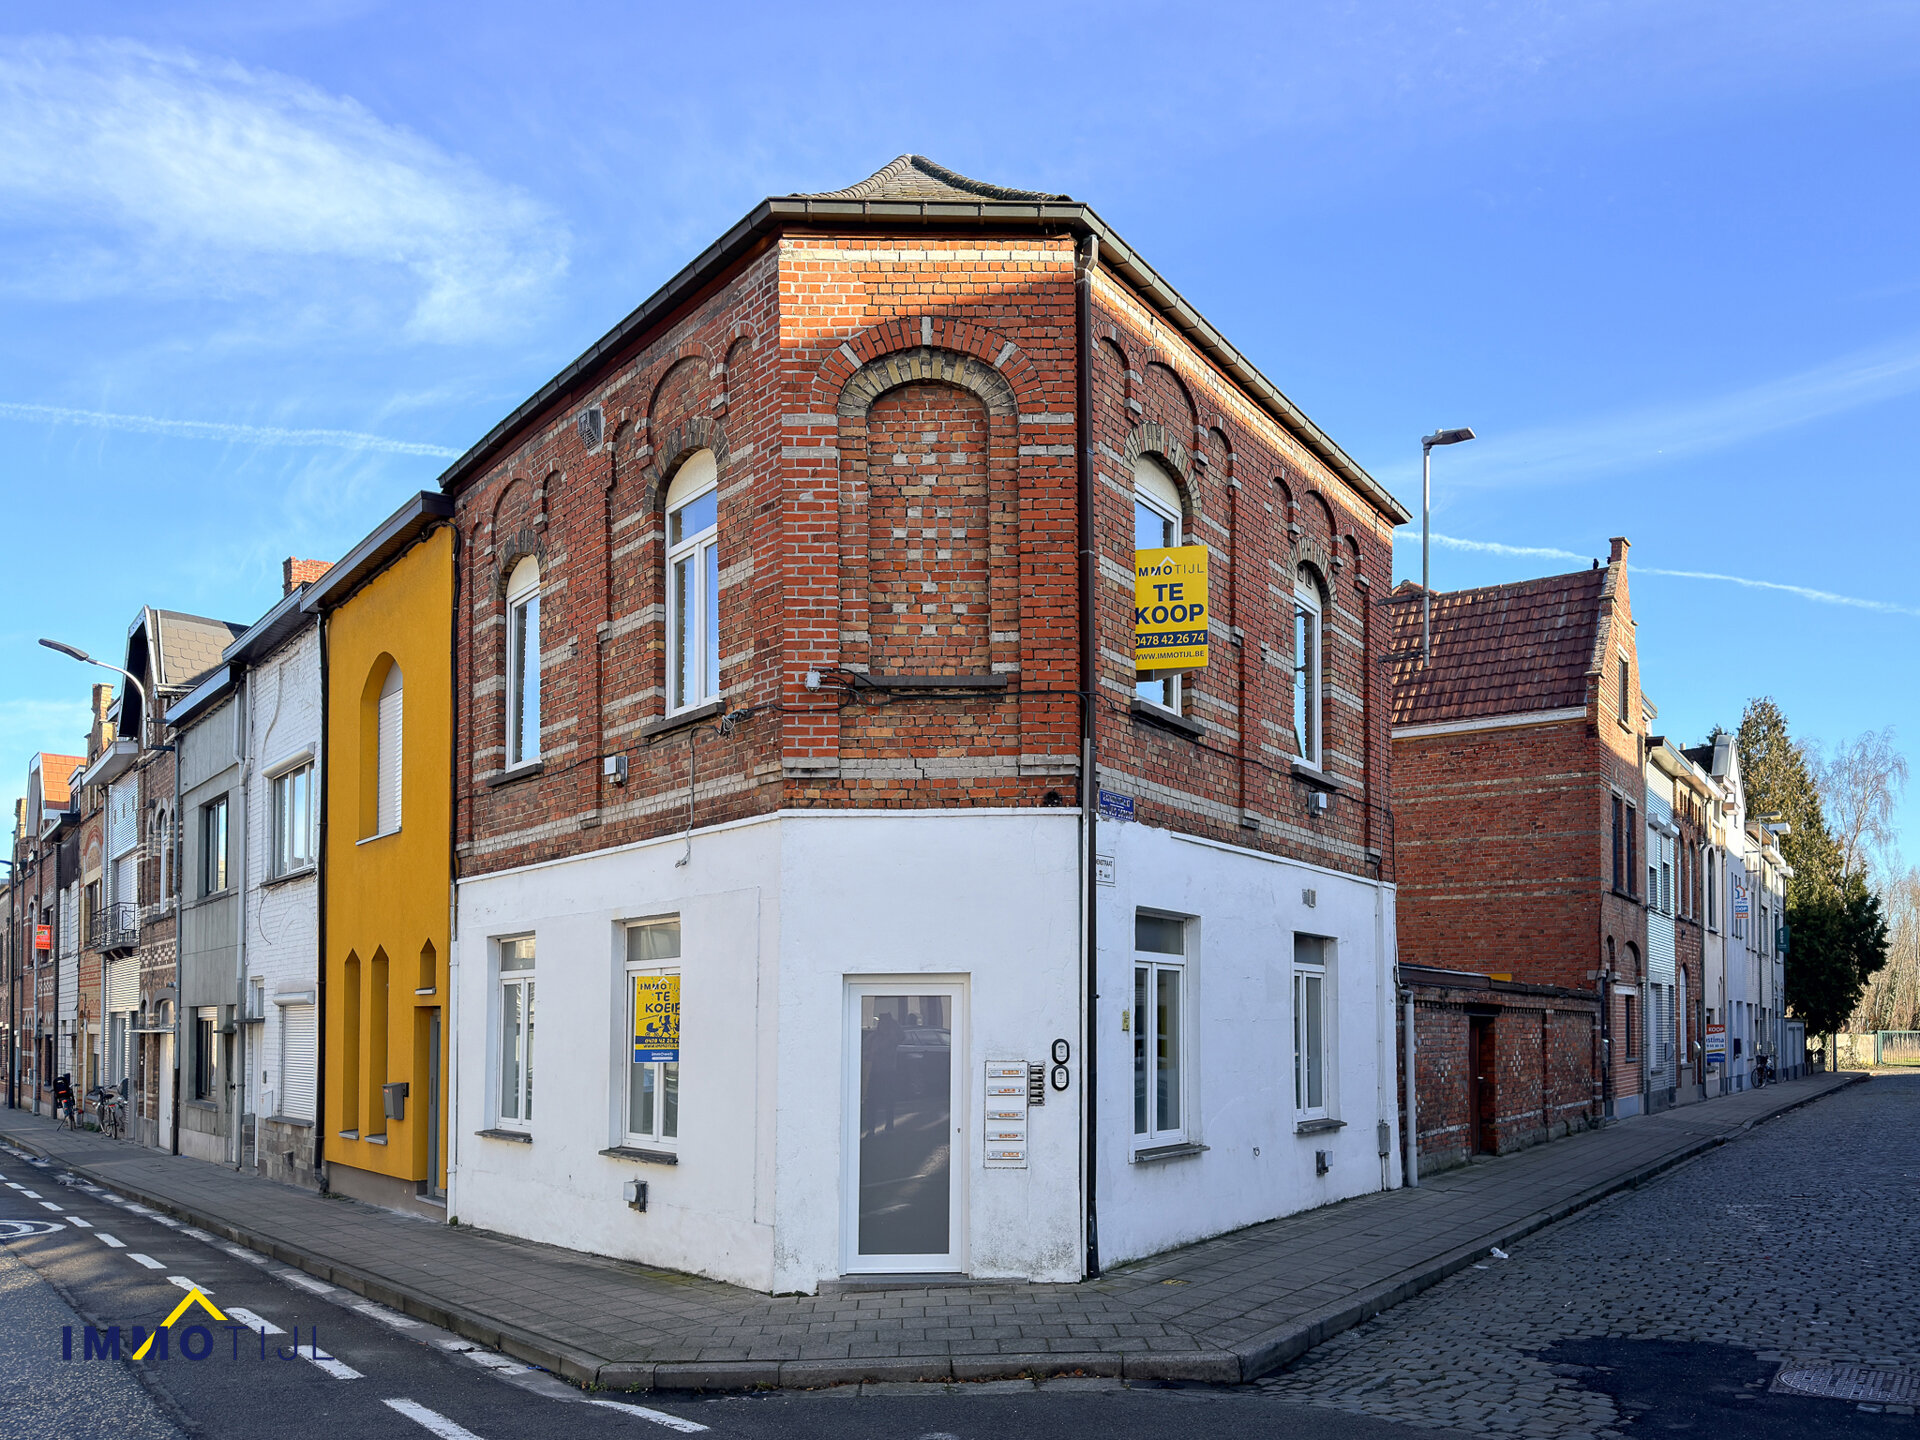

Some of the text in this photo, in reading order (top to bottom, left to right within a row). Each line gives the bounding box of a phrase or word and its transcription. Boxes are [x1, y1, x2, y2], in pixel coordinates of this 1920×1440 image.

[1138, 564, 1204, 577] MMOTIJL
[1153, 583, 1184, 602] TE
[1136, 604, 1205, 625] KOOP
[1136, 633, 1205, 646] 0478 42 26 74
[1136, 650, 1205, 660] WWW.IMMOTIJL.BE
[655, 991, 670, 1002] TE
